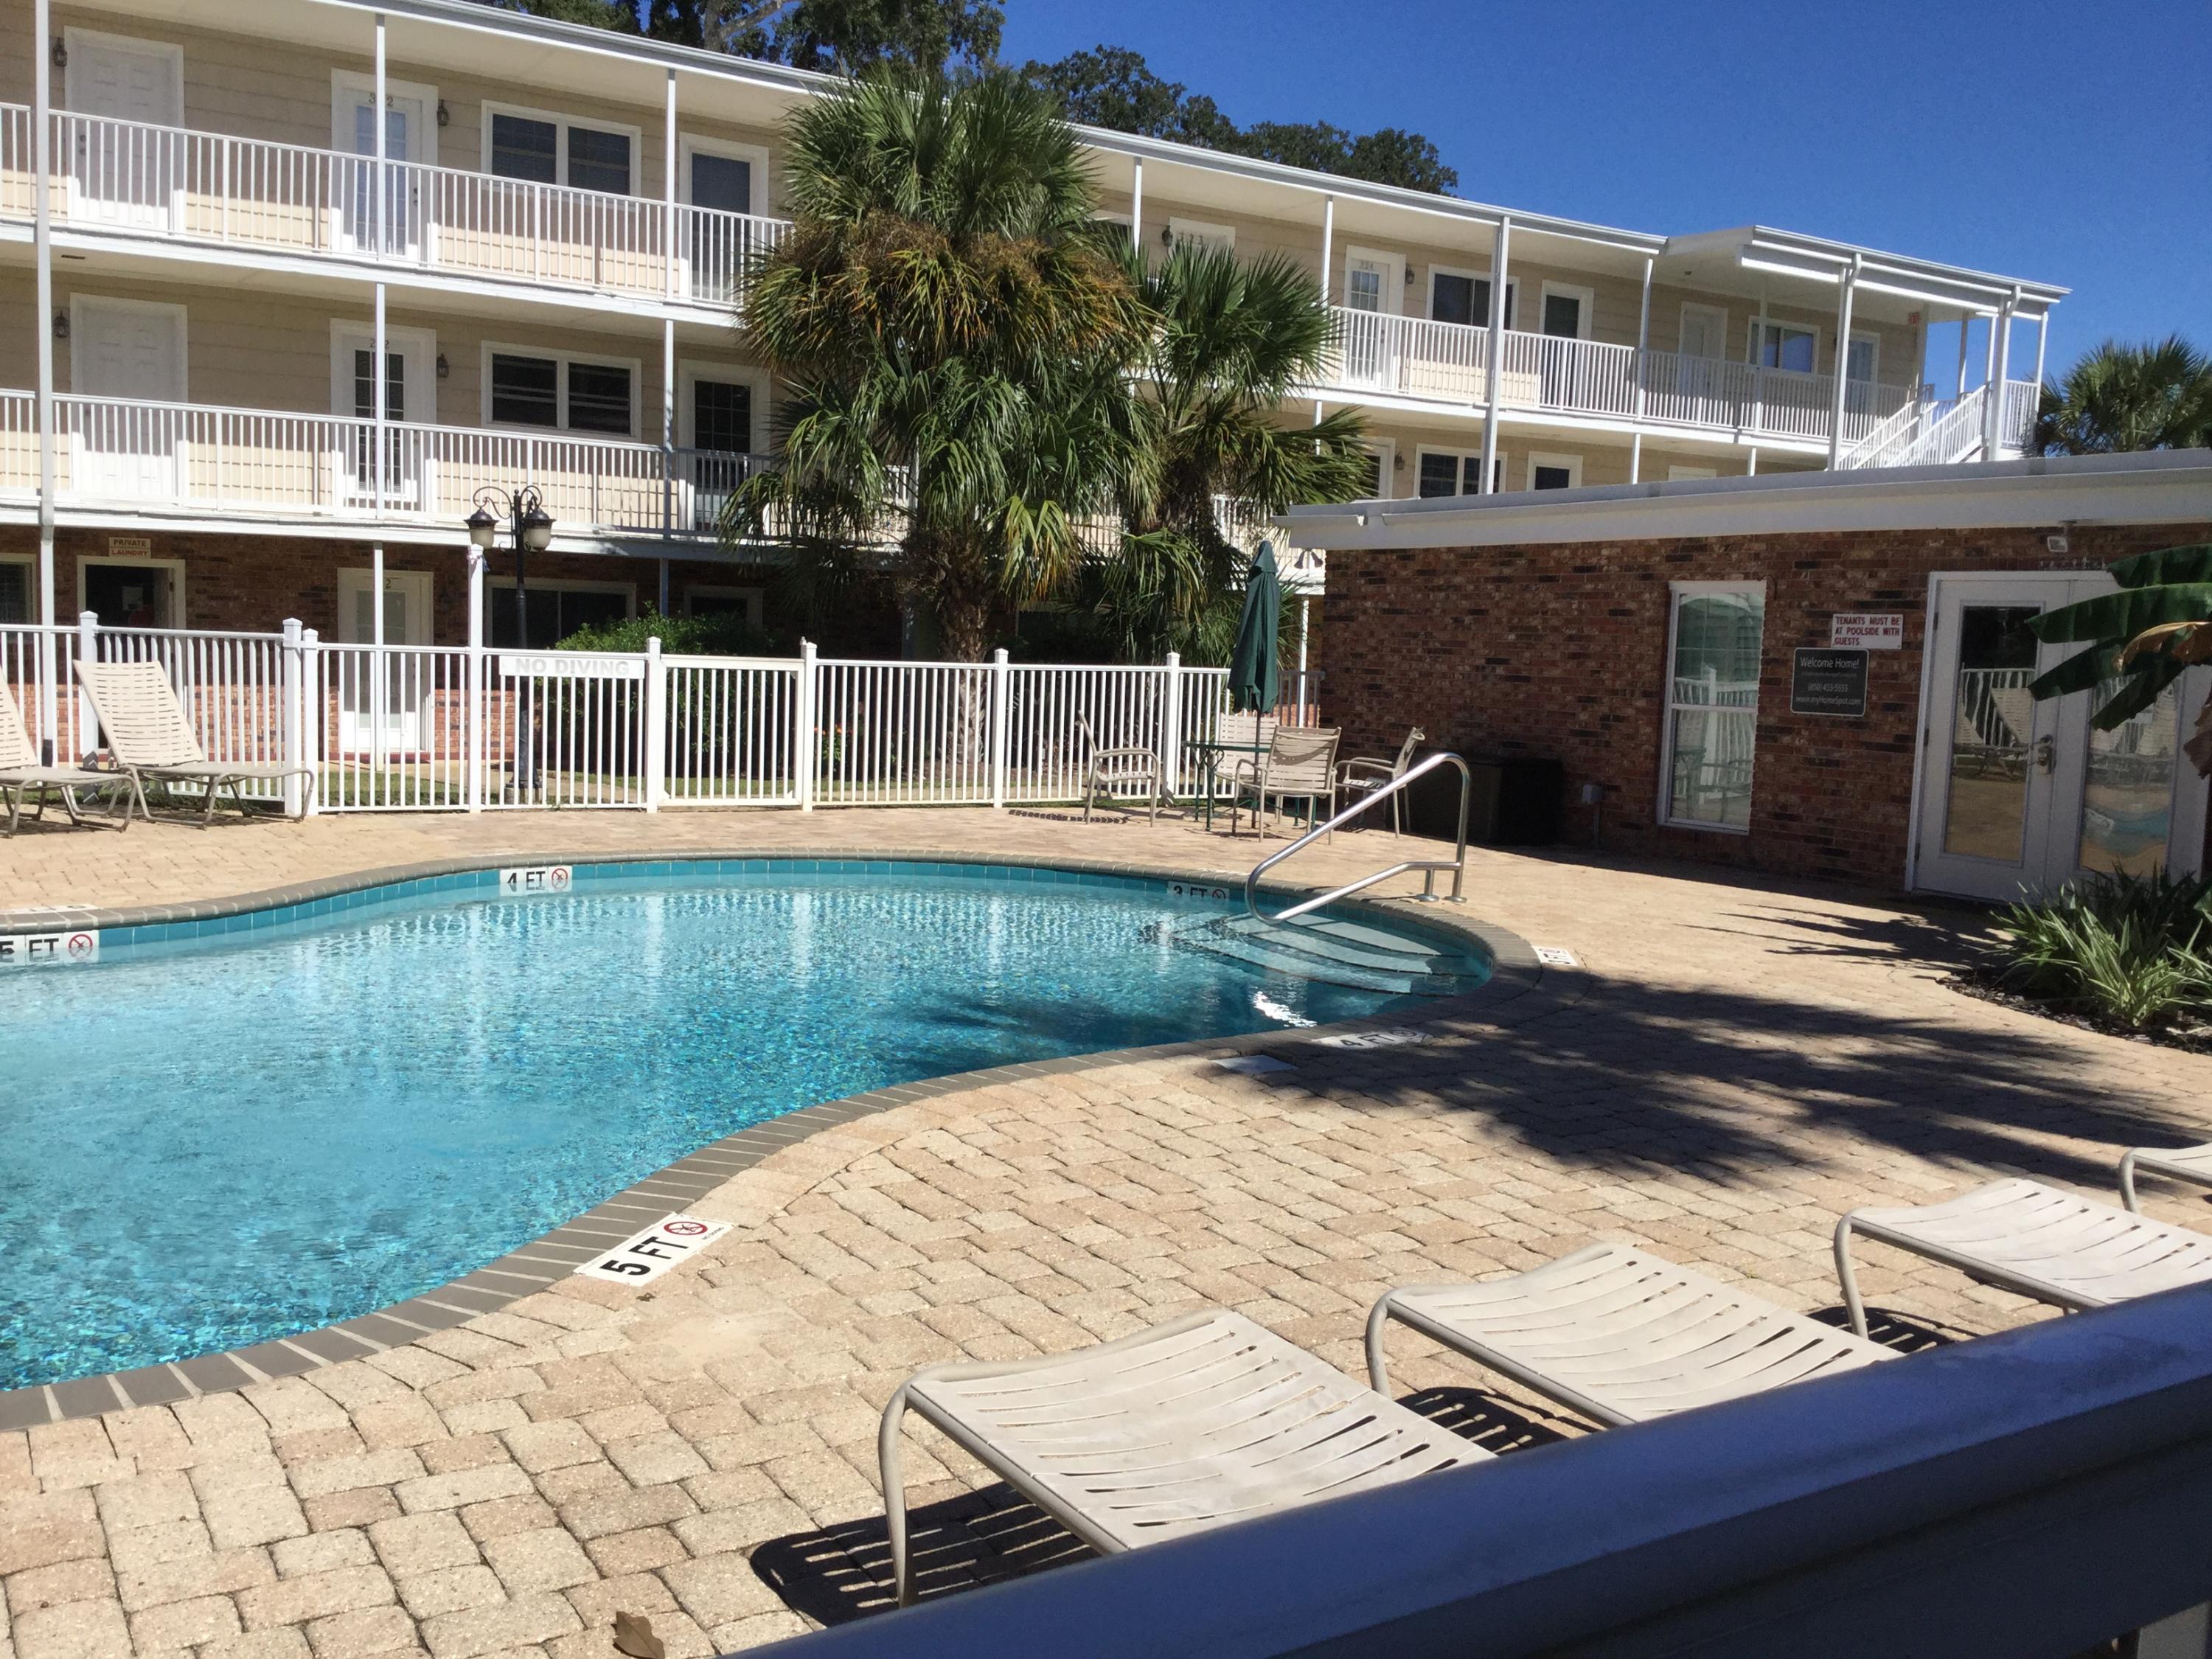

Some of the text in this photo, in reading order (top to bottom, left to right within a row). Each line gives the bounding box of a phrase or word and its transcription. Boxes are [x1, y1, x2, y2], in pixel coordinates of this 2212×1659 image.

[369, 92, 394, 107] 32
[1835, 616, 1900, 625] TENANTS MUST BE
[1835, 627, 1900, 636] AT POOLSIDE WITH
[1834, 636, 1860, 646] GUESTS
[515, 658, 630, 676] NO DIVING
[1800, 656, 1860, 669] Welcome Home!
[29, 938, 59, 953] FT
[1357, 1034, 1395, 1044] FT
[599, 1236, 689, 1276] 5 FT
